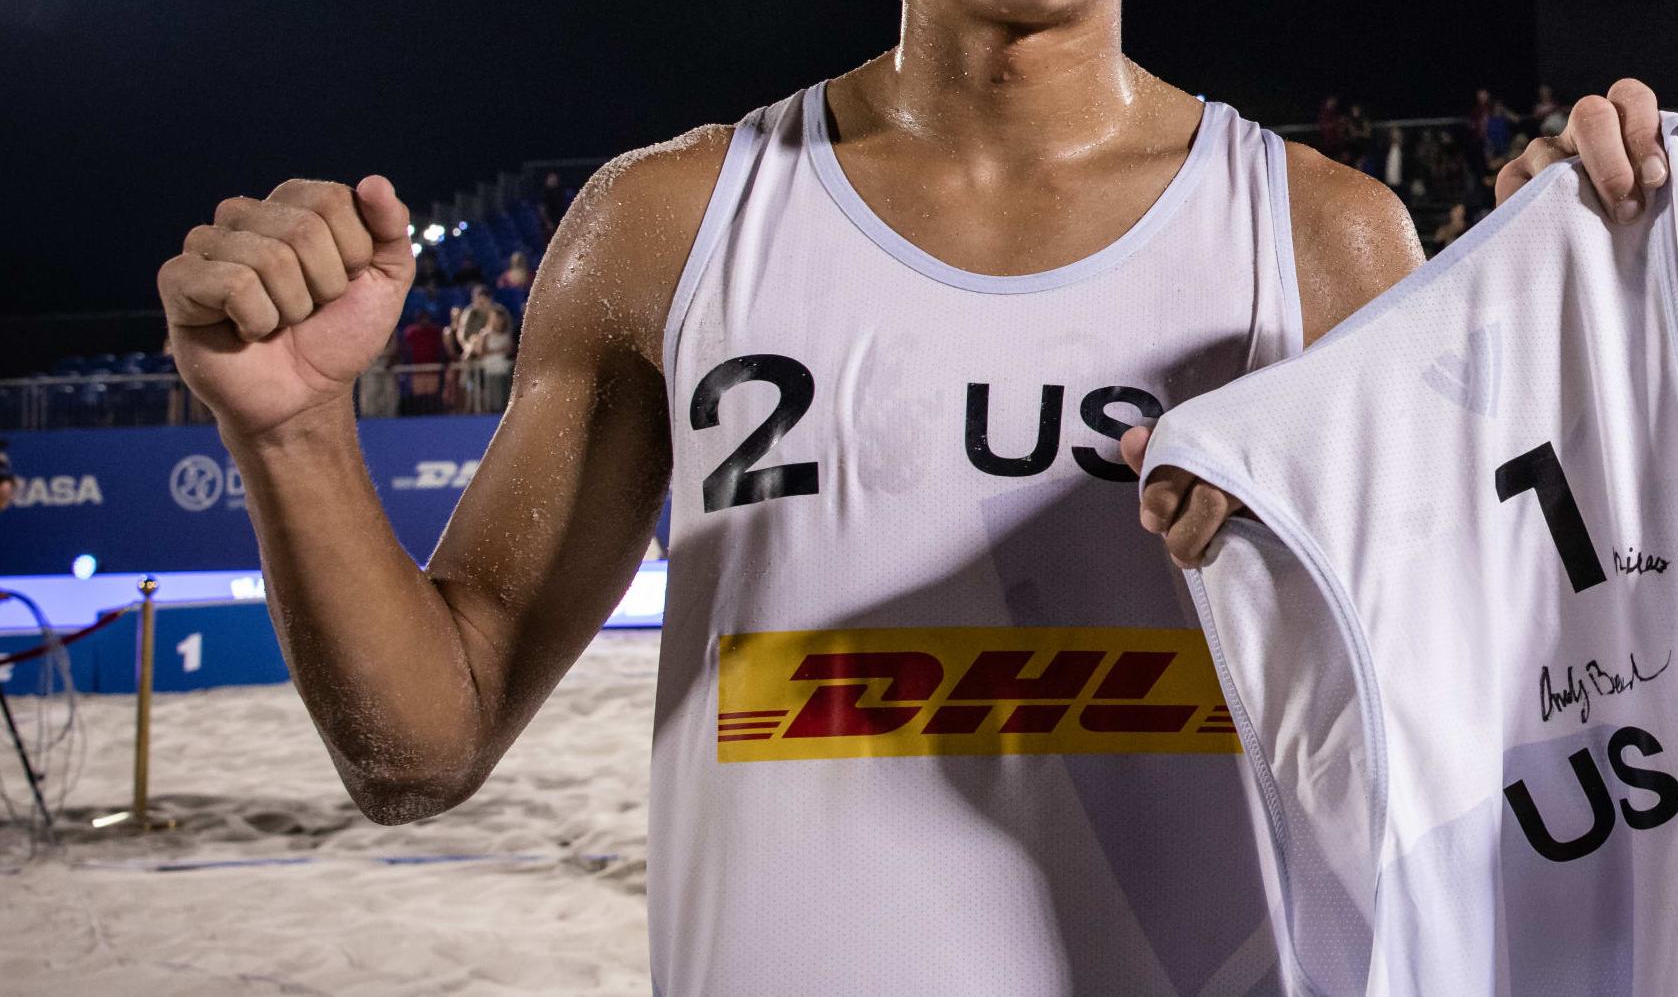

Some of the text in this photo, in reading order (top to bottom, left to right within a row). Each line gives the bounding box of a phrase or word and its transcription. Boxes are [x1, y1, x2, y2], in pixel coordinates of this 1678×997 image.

[690, 354, 819, 513] 2
[1495, 441, 1607, 593] 1
[177, 633, 201, 673] 1
[780, 651, 1199, 737] DHL
